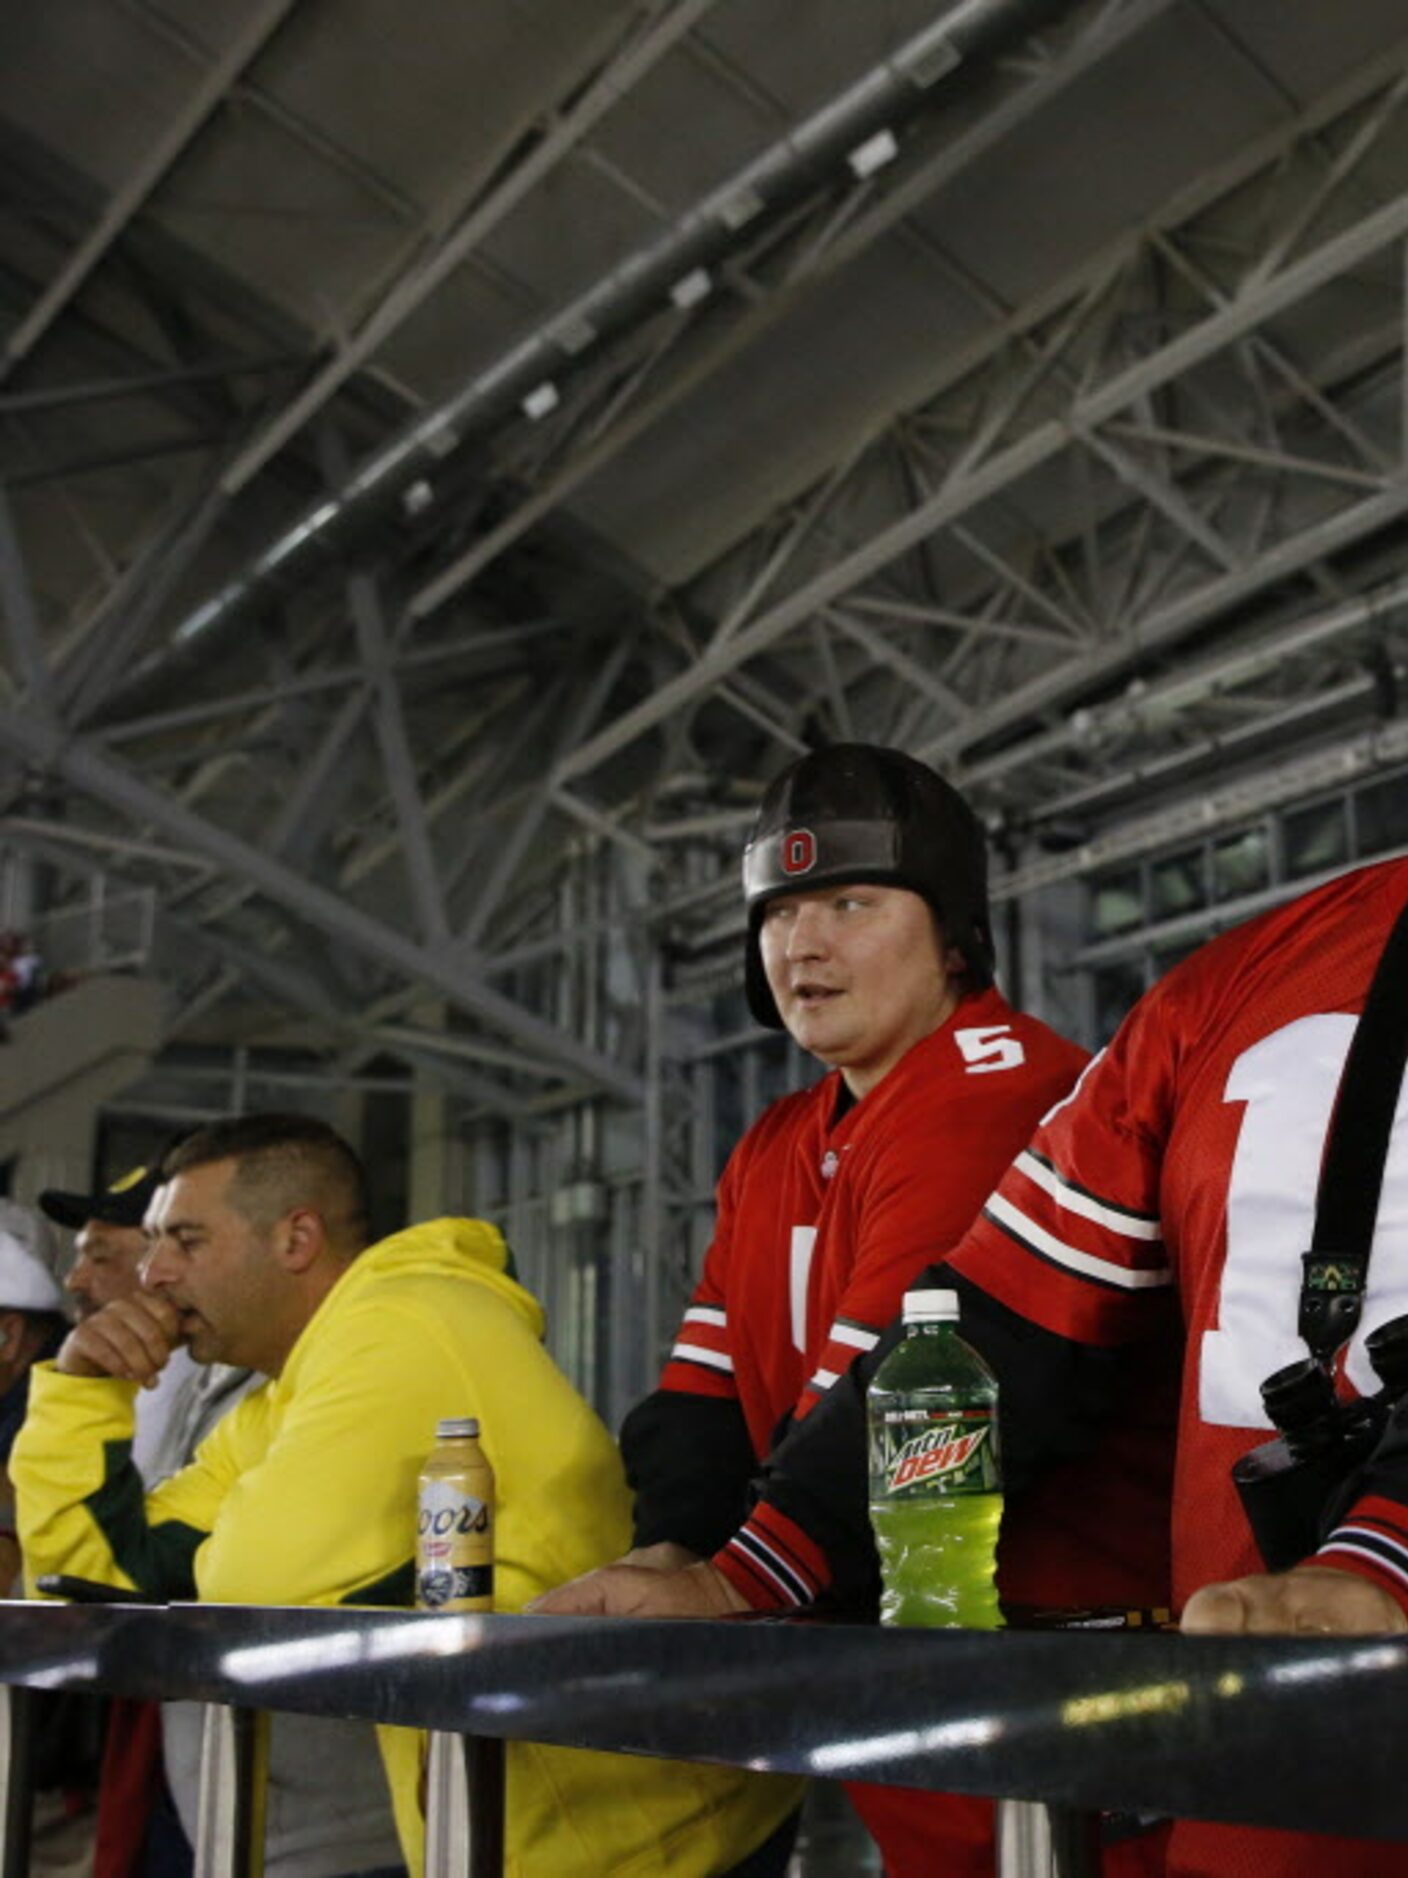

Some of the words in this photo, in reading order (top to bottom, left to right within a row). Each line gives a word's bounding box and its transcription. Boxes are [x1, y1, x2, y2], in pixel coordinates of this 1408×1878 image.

[781, 827, 817, 875] O
[954, 1024, 1026, 1074] 5
[418, 1504, 489, 1535] oors
